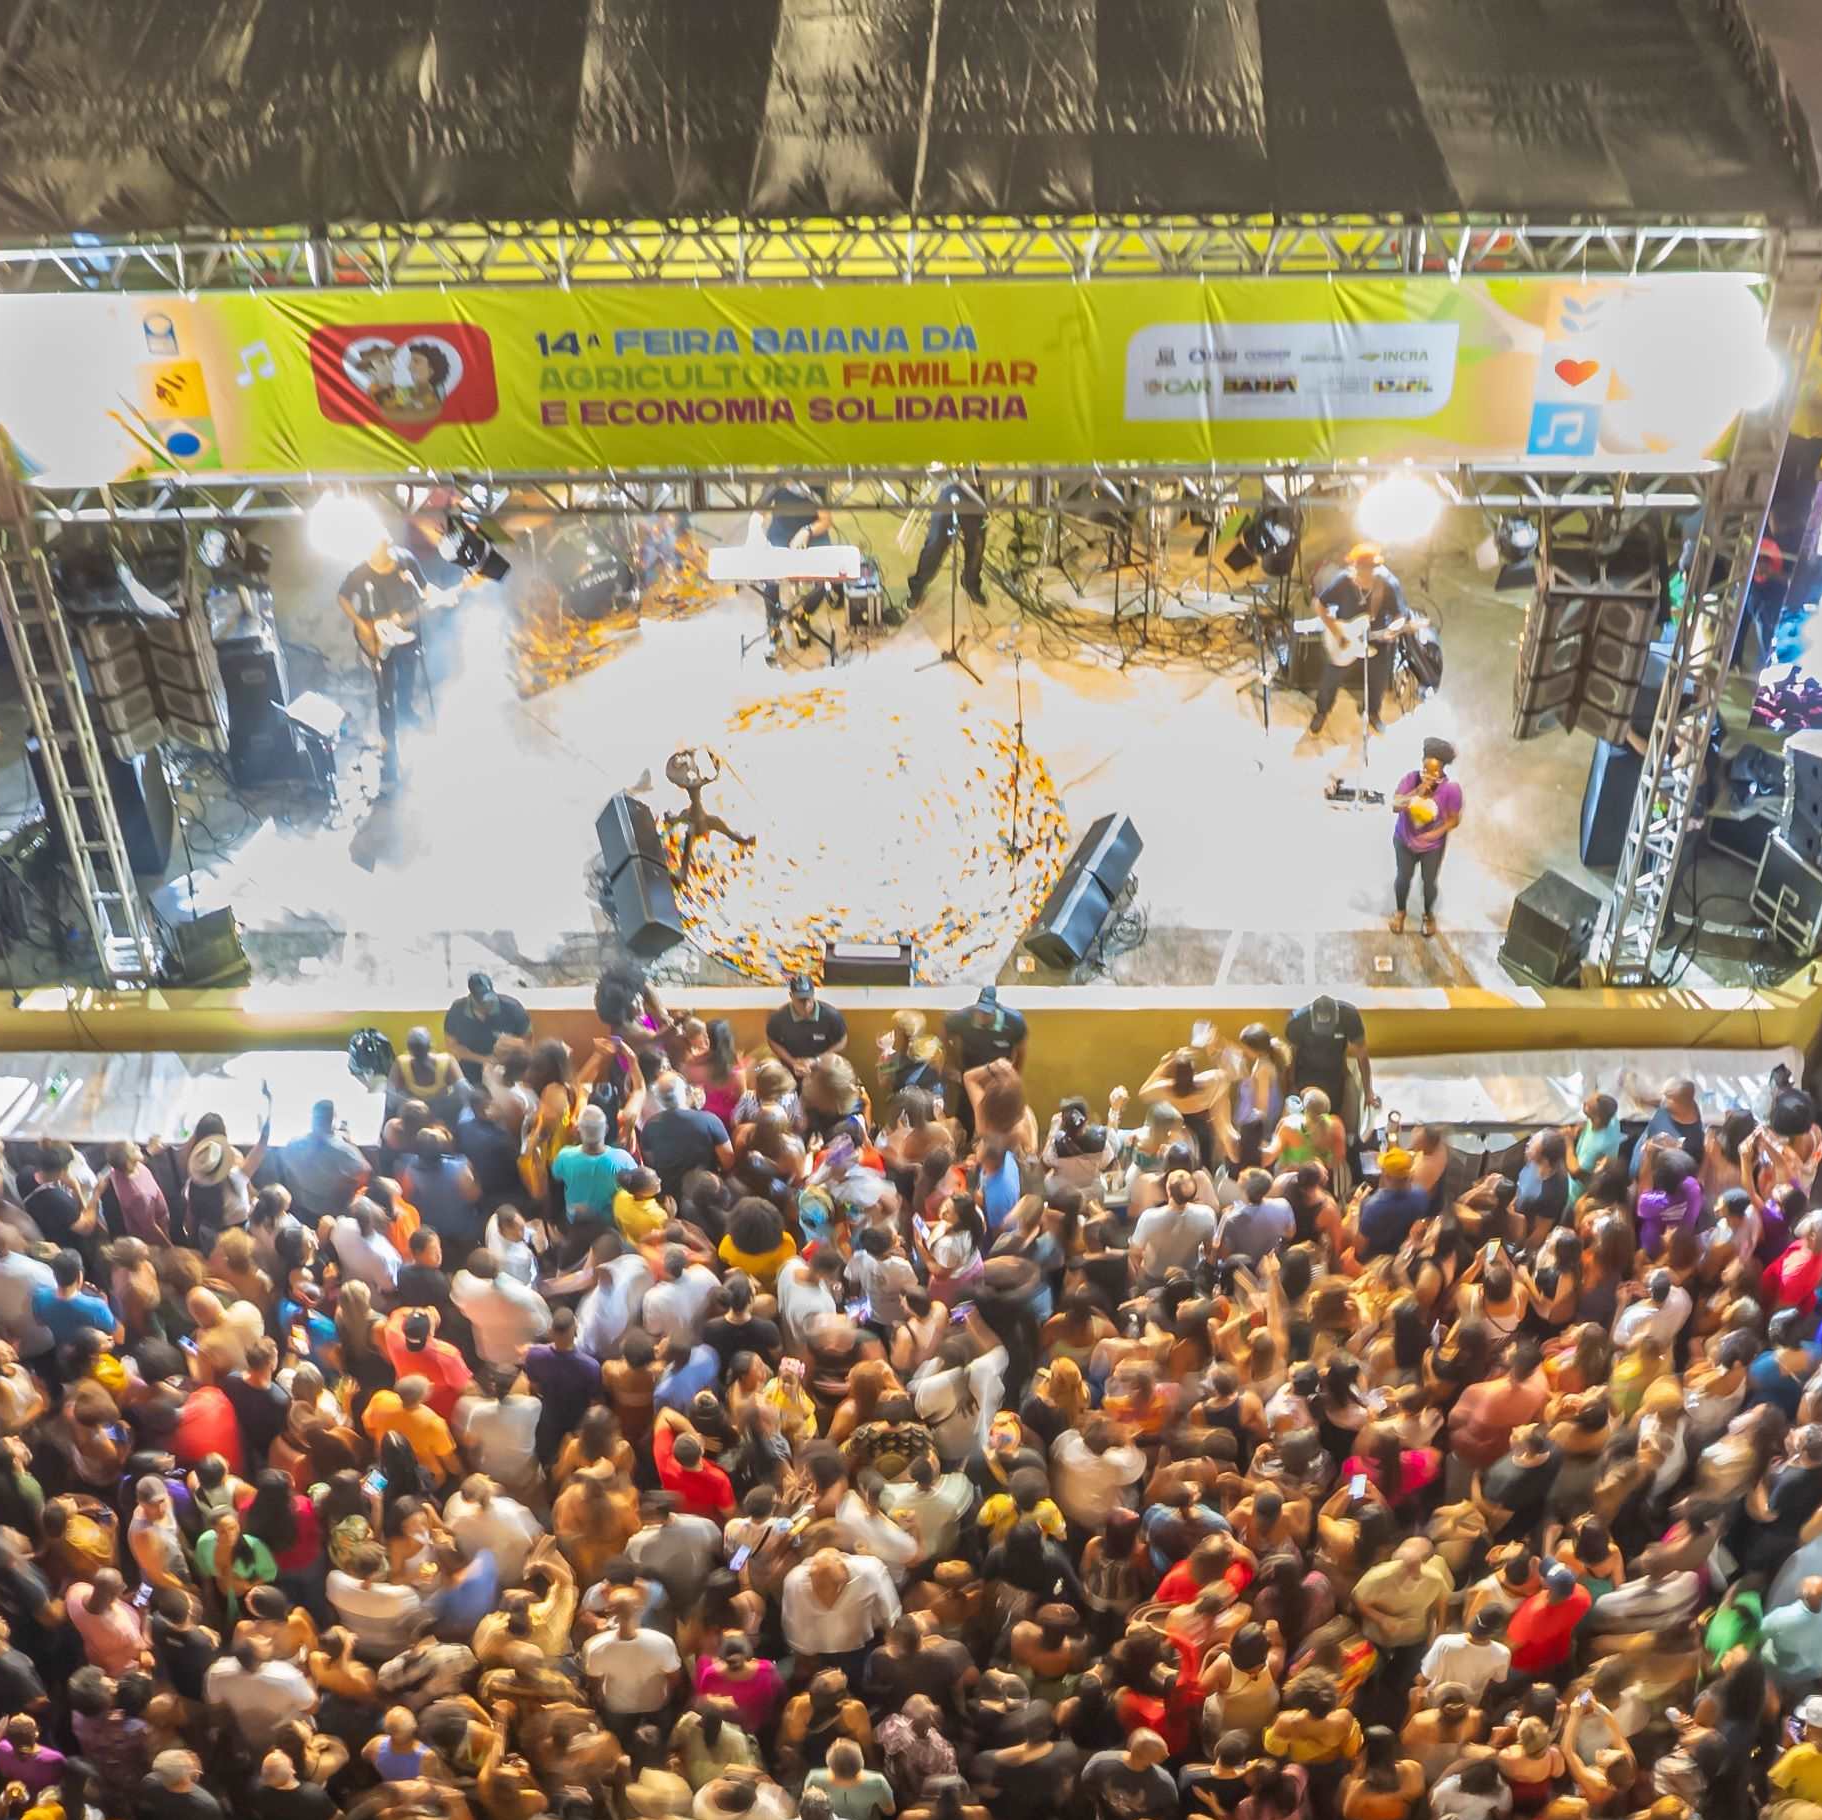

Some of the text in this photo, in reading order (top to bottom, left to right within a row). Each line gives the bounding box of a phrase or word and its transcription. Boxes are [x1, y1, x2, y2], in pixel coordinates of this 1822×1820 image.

[613, 328, 740, 356] FEIRA
[752, 327, 909, 355] BAIANA
[922, 325, 978, 353] DA
[1383, 350, 1428, 362] INCRA
[539, 360, 1038, 391] AGRICULTURA FAMILIAR
[541, 400, 568, 426] E
[580, 396, 796, 426] ECONOMIA
